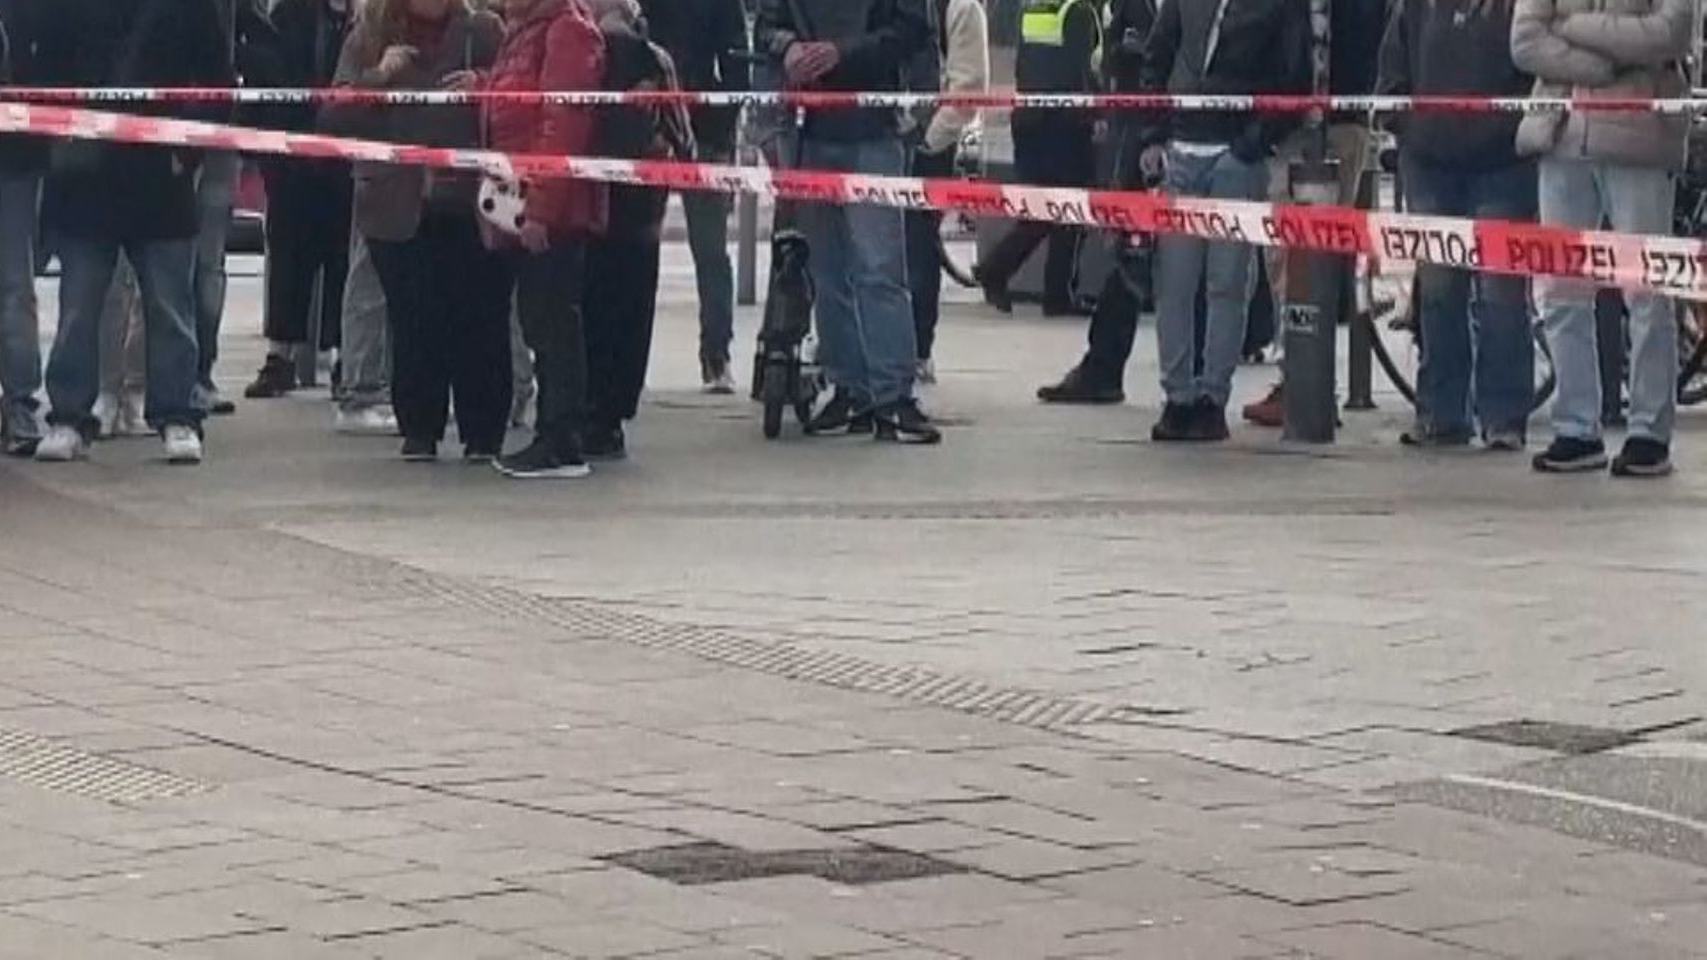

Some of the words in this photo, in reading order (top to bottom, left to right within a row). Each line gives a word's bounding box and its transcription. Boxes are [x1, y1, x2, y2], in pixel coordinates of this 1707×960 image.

[1262, 215, 1364, 255] POLIZEI
[1380, 225, 1483, 266] POLIZEI
[1506, 236, 1617, 282] POLIZEI
